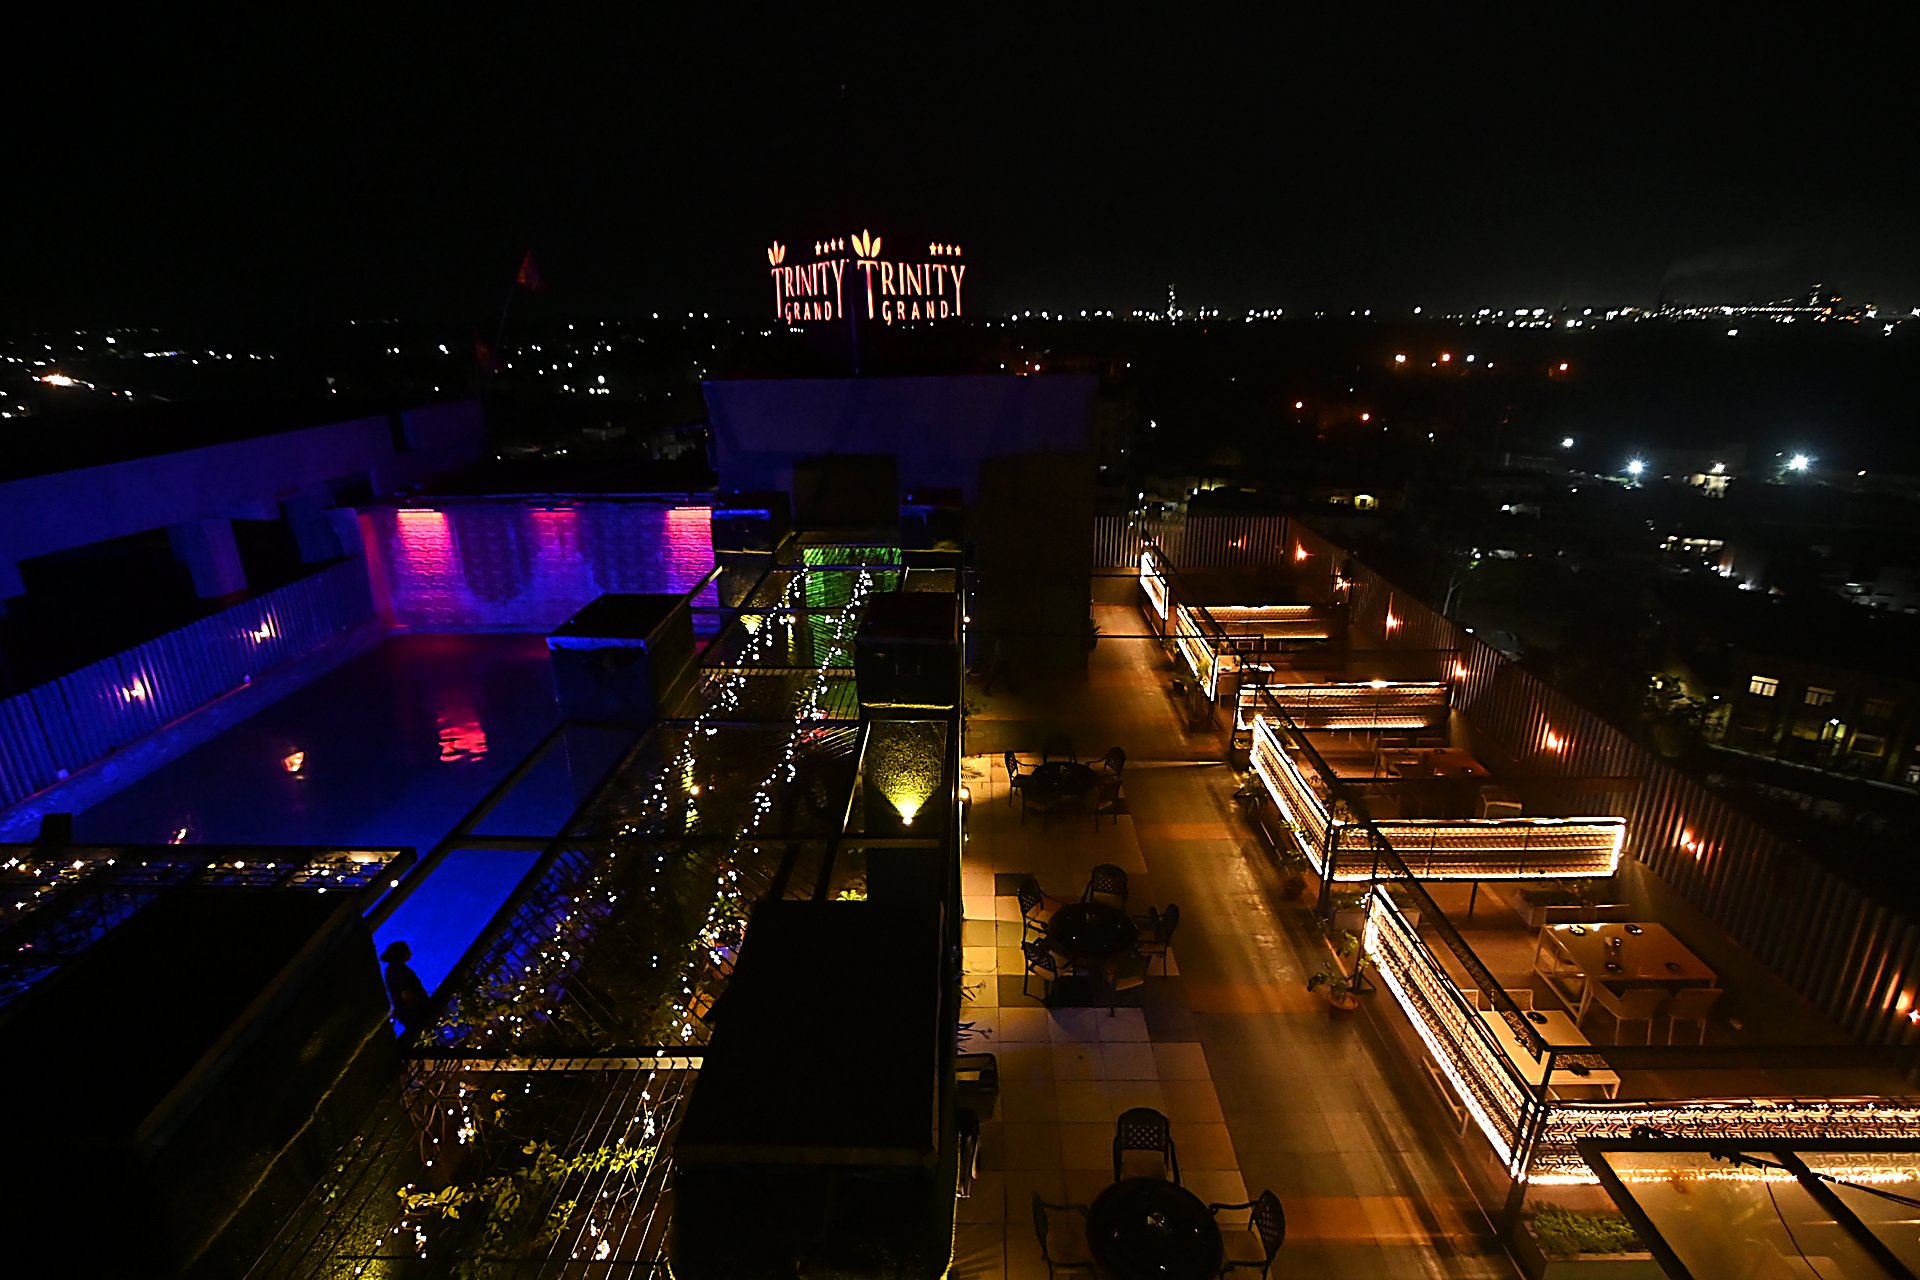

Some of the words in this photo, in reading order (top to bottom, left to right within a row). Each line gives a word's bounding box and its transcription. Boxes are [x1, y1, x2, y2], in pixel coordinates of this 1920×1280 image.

[771, 259, 845, 319] TRINITY
[857, 260, 966, 319] TRINITY
[785, 301, 832, 325] GRAND
[882, 301, 949, 325] GRAND
